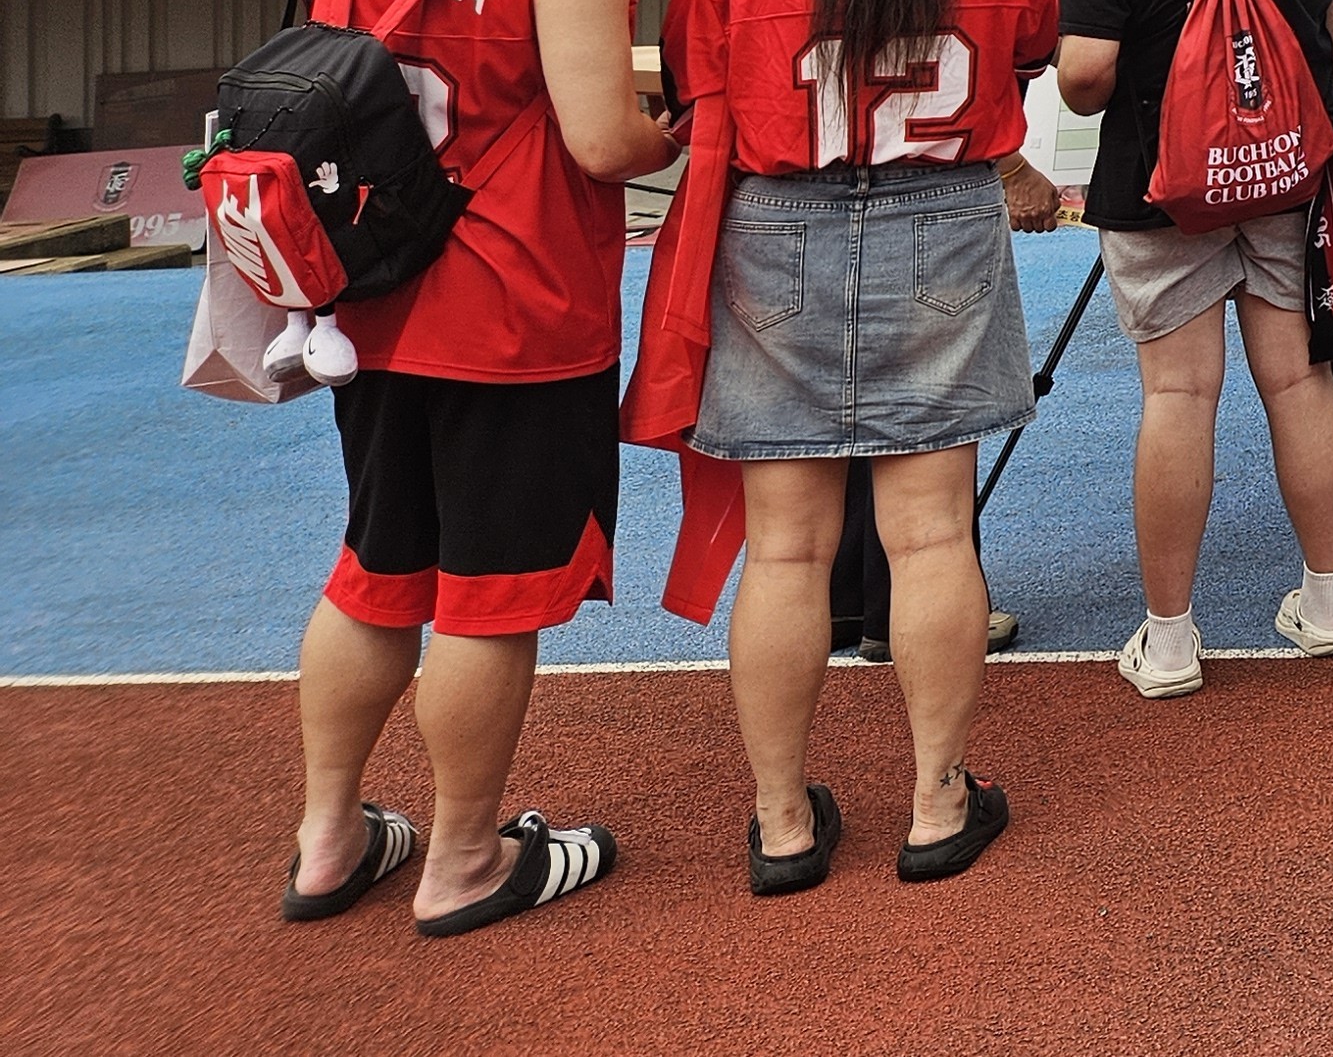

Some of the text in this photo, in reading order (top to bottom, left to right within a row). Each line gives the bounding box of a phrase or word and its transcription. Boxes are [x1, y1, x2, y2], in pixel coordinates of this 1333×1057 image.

[796, 29, 976, 170] 12
[1208, 125, 1302, 166] BUCHEON
[1205, 183, 1267, 205] CLUB
[130, 213, 183, 238] 995
